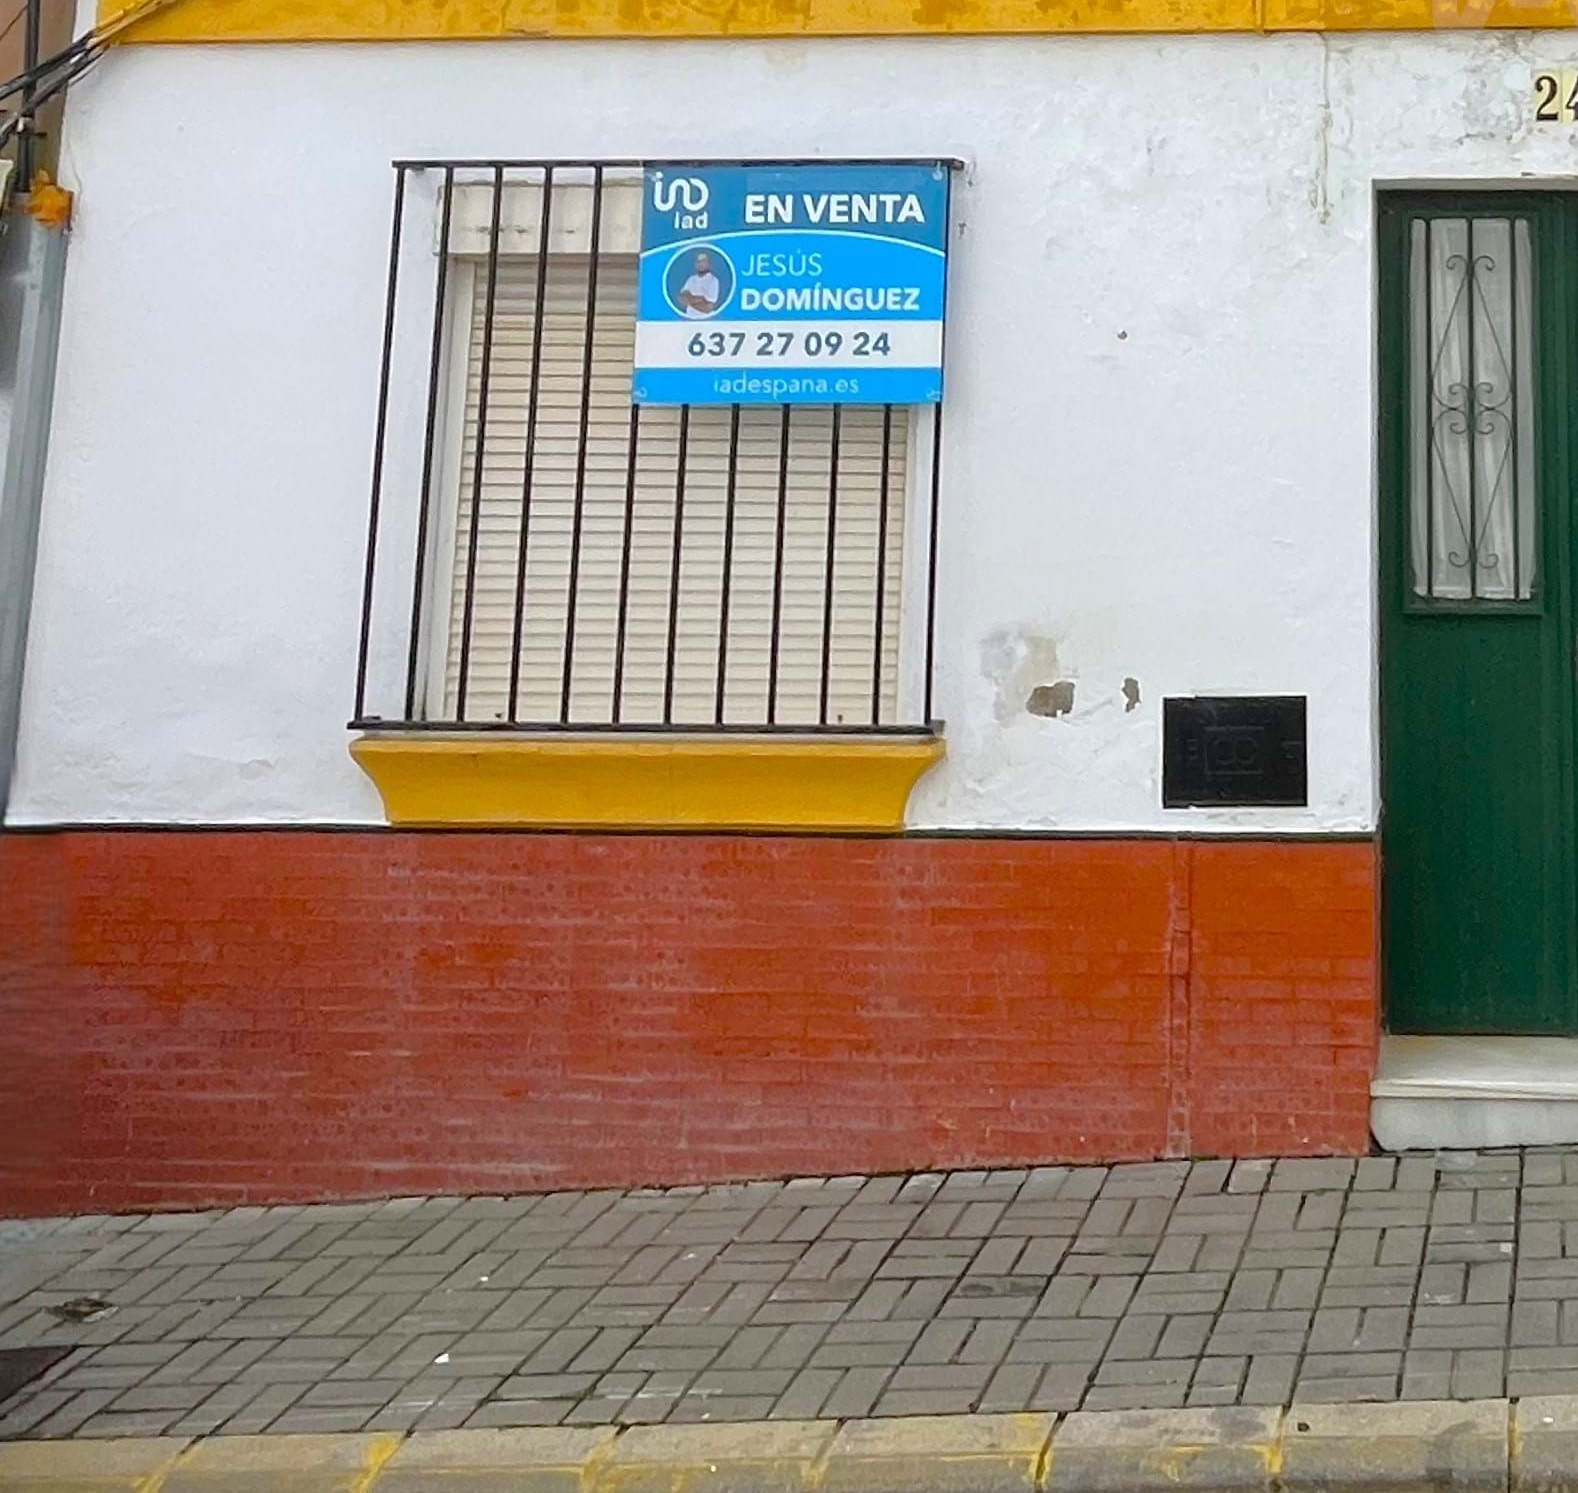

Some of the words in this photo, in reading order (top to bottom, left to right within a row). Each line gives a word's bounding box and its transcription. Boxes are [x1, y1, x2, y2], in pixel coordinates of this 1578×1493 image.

[744, 194, 793, 224] EN
[804, 193, 926, 224] VENTA
[741, 248, 823, 277] JESÚS
[740, 282, 921, 312] DOMÍNGUEZ
[687, 332, 746, 357] 637
[756, 332, 794, 357] 27
[804, 331, 843, 356] 09
[852, 331, 892, 356] 24
[712, 373, 860, 398] iadespana.es
